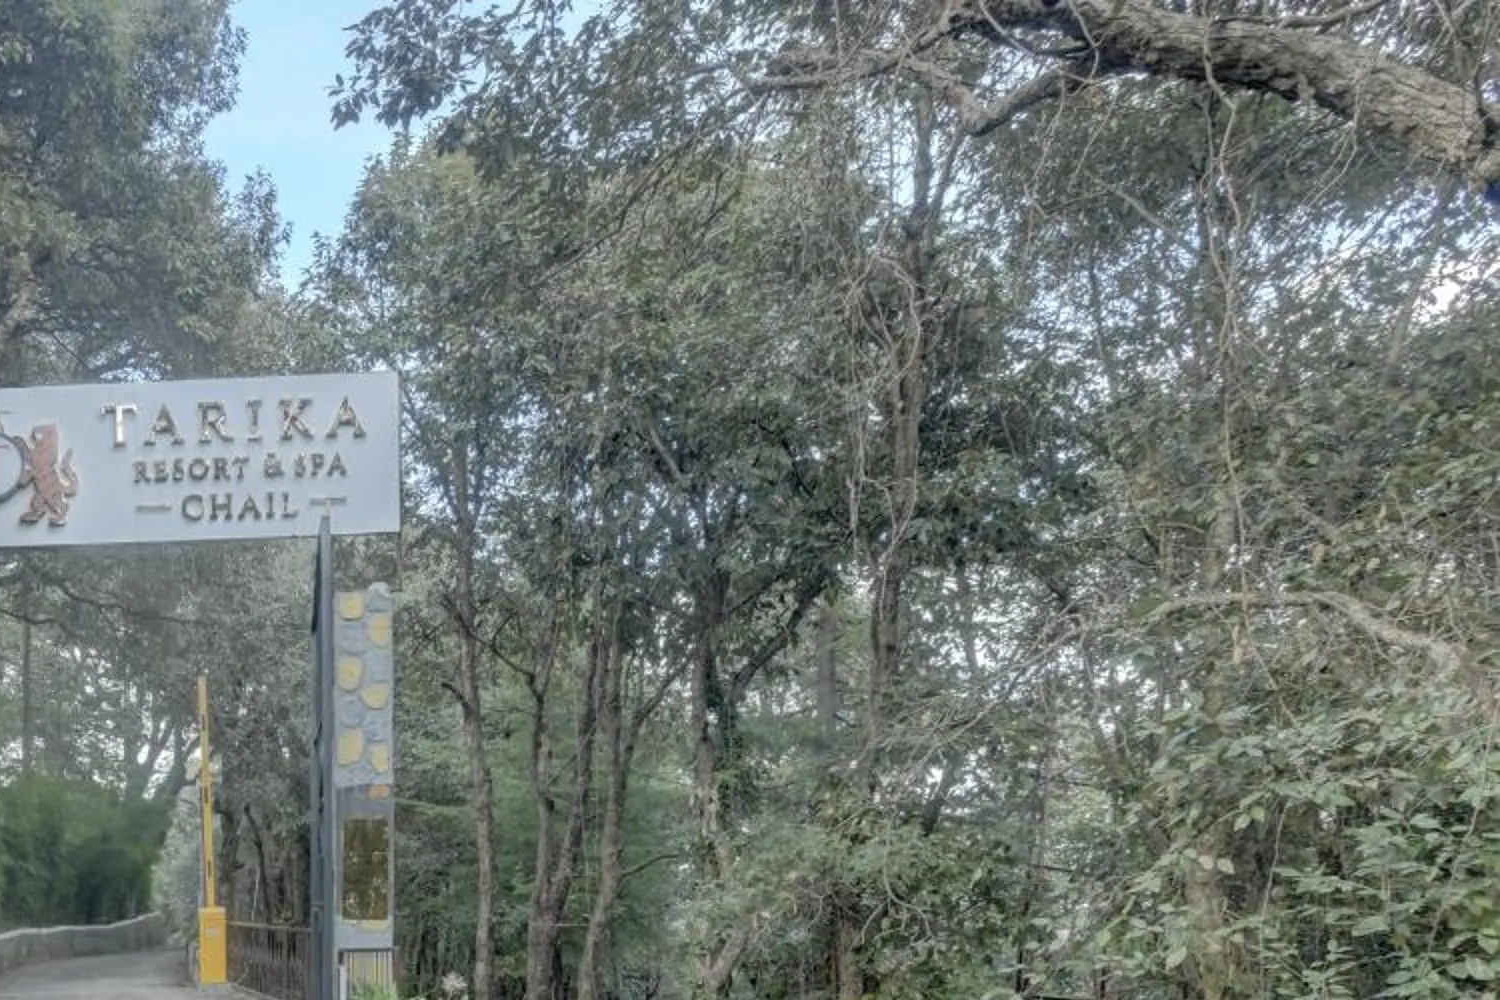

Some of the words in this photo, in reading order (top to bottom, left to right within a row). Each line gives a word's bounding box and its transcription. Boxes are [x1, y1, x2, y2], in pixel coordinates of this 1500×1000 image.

[102, 397, 367, 449] TARIKA
[132, 457, 250, 484] RESORT
[263, 453, 285, 479] &
[294, 451, 348, 478] SPA
[181, 491, 299, 521] CHAIL
